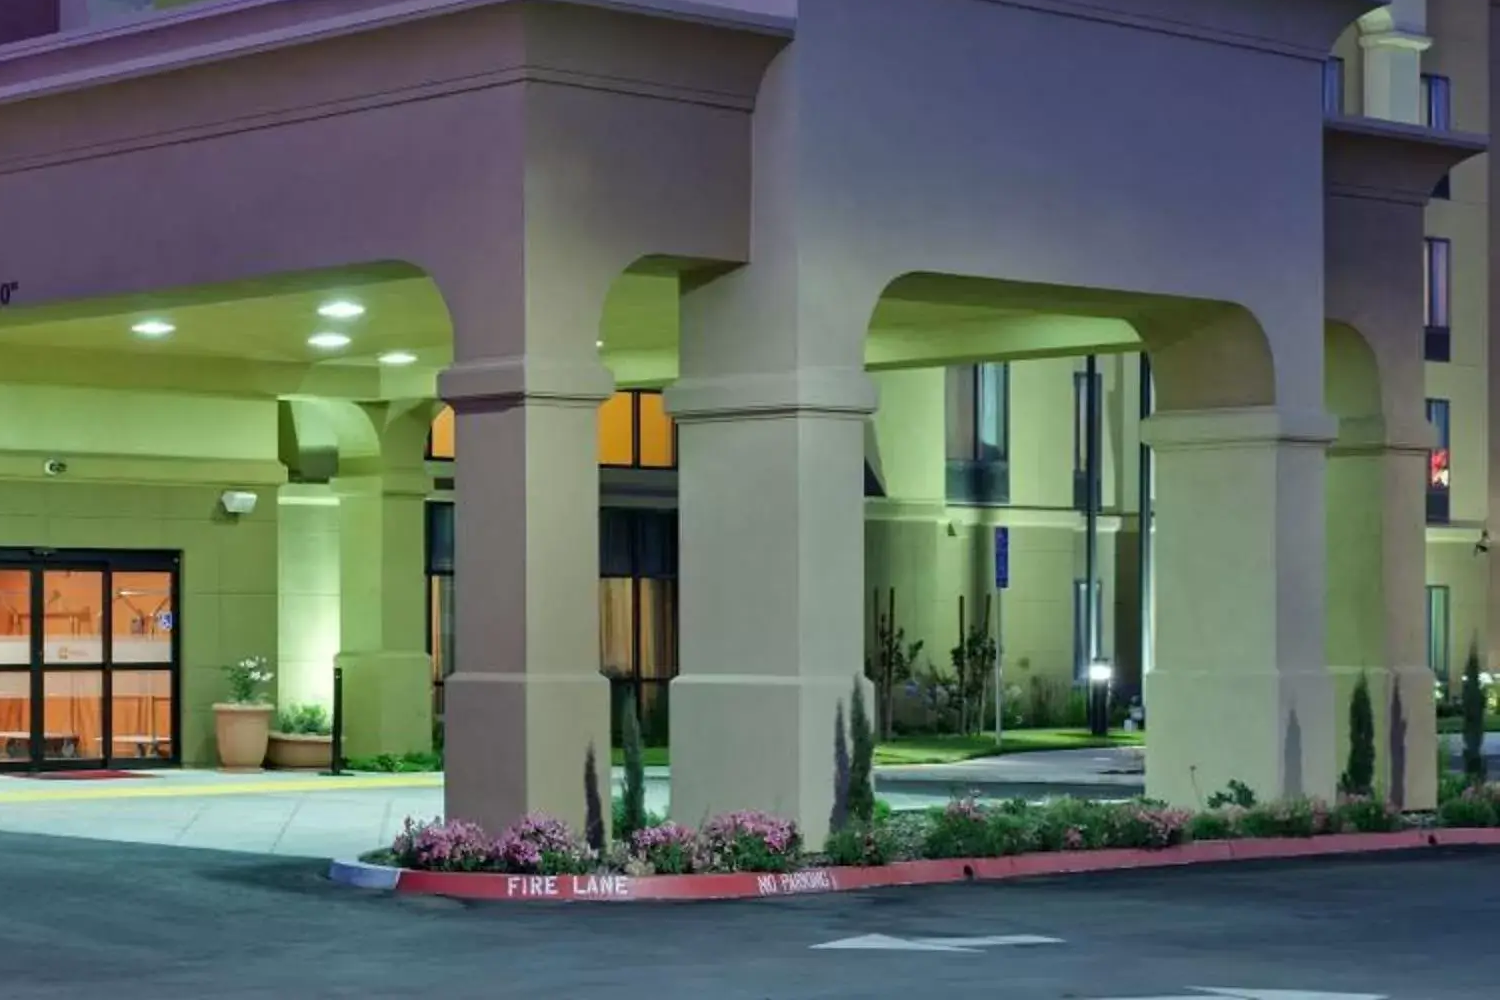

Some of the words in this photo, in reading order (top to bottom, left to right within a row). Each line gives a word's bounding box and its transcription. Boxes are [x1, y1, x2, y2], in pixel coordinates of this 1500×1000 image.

[507, 875, 559, 896] FIRE
[573, 874, 628, 896] LANE
[757, 874, 777, 896] NO
